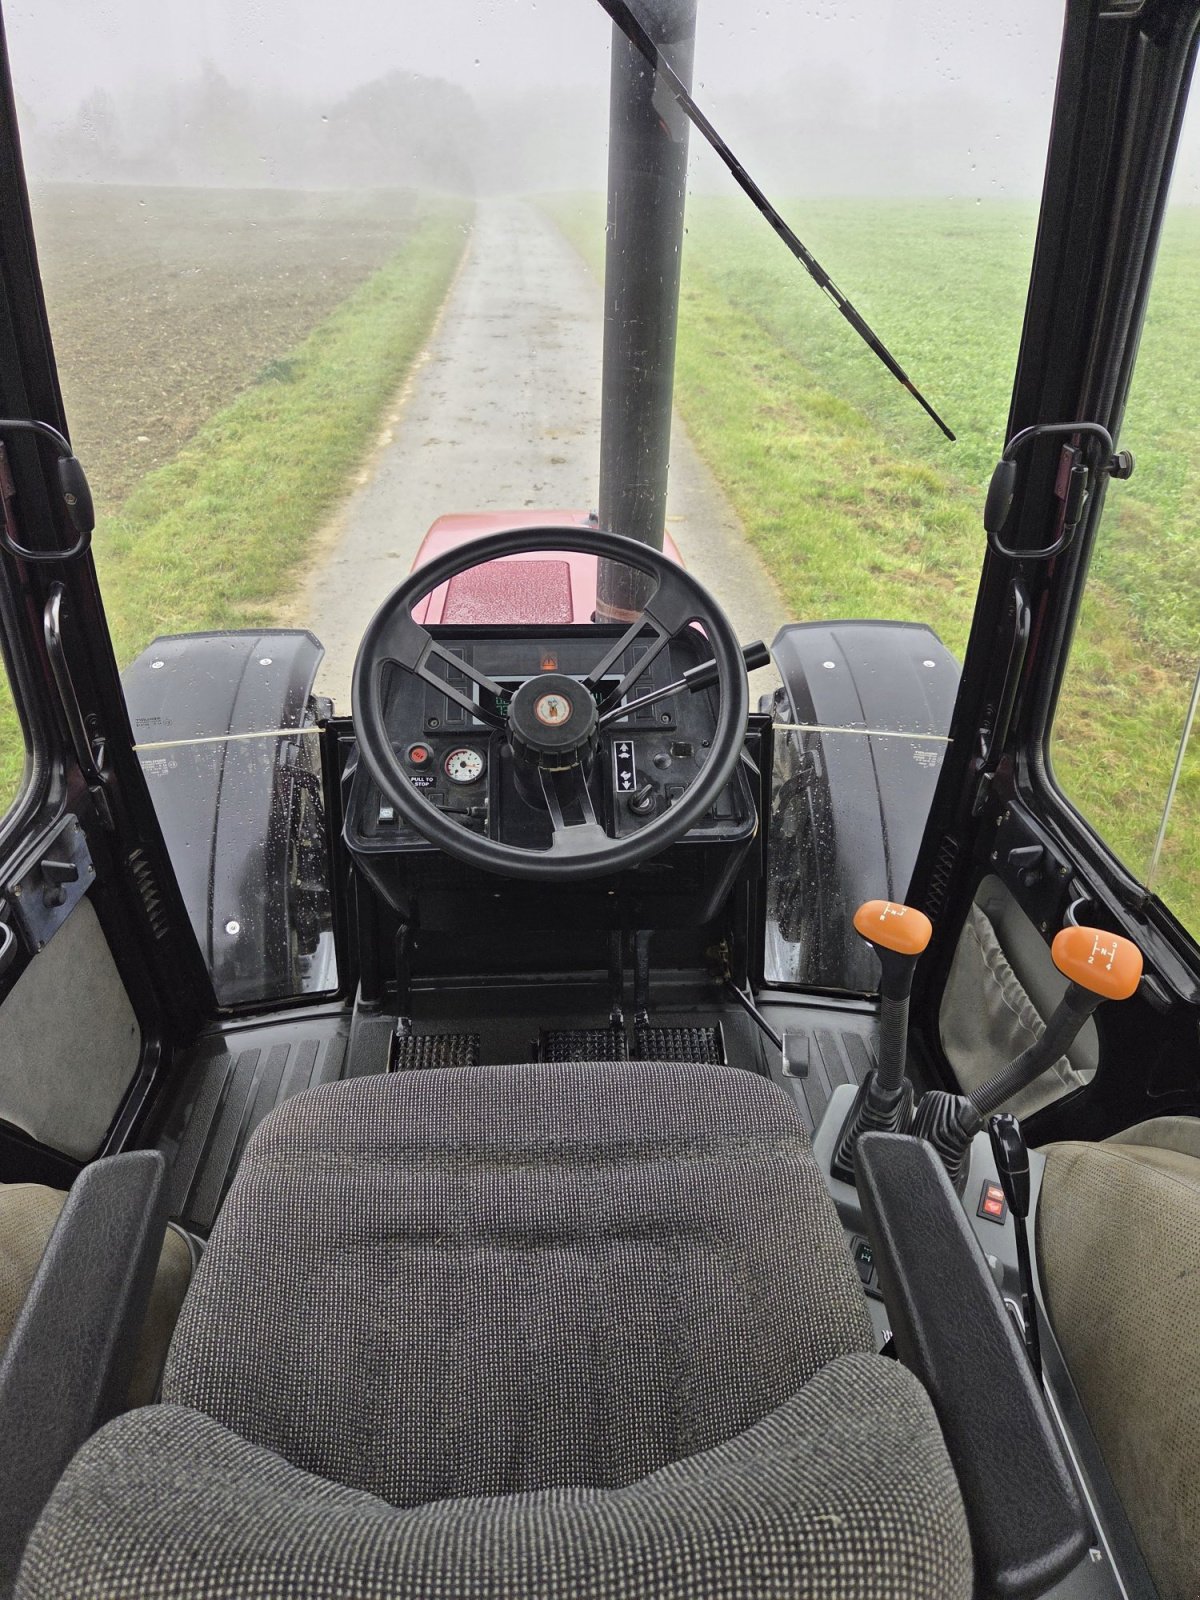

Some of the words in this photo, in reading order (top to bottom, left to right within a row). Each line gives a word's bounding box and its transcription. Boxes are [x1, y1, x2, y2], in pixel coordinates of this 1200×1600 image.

[1100, 947, 1107, 955] N
[1087, 955, 1094, 964] 2
[1105, 963, 1112, 971] 4
